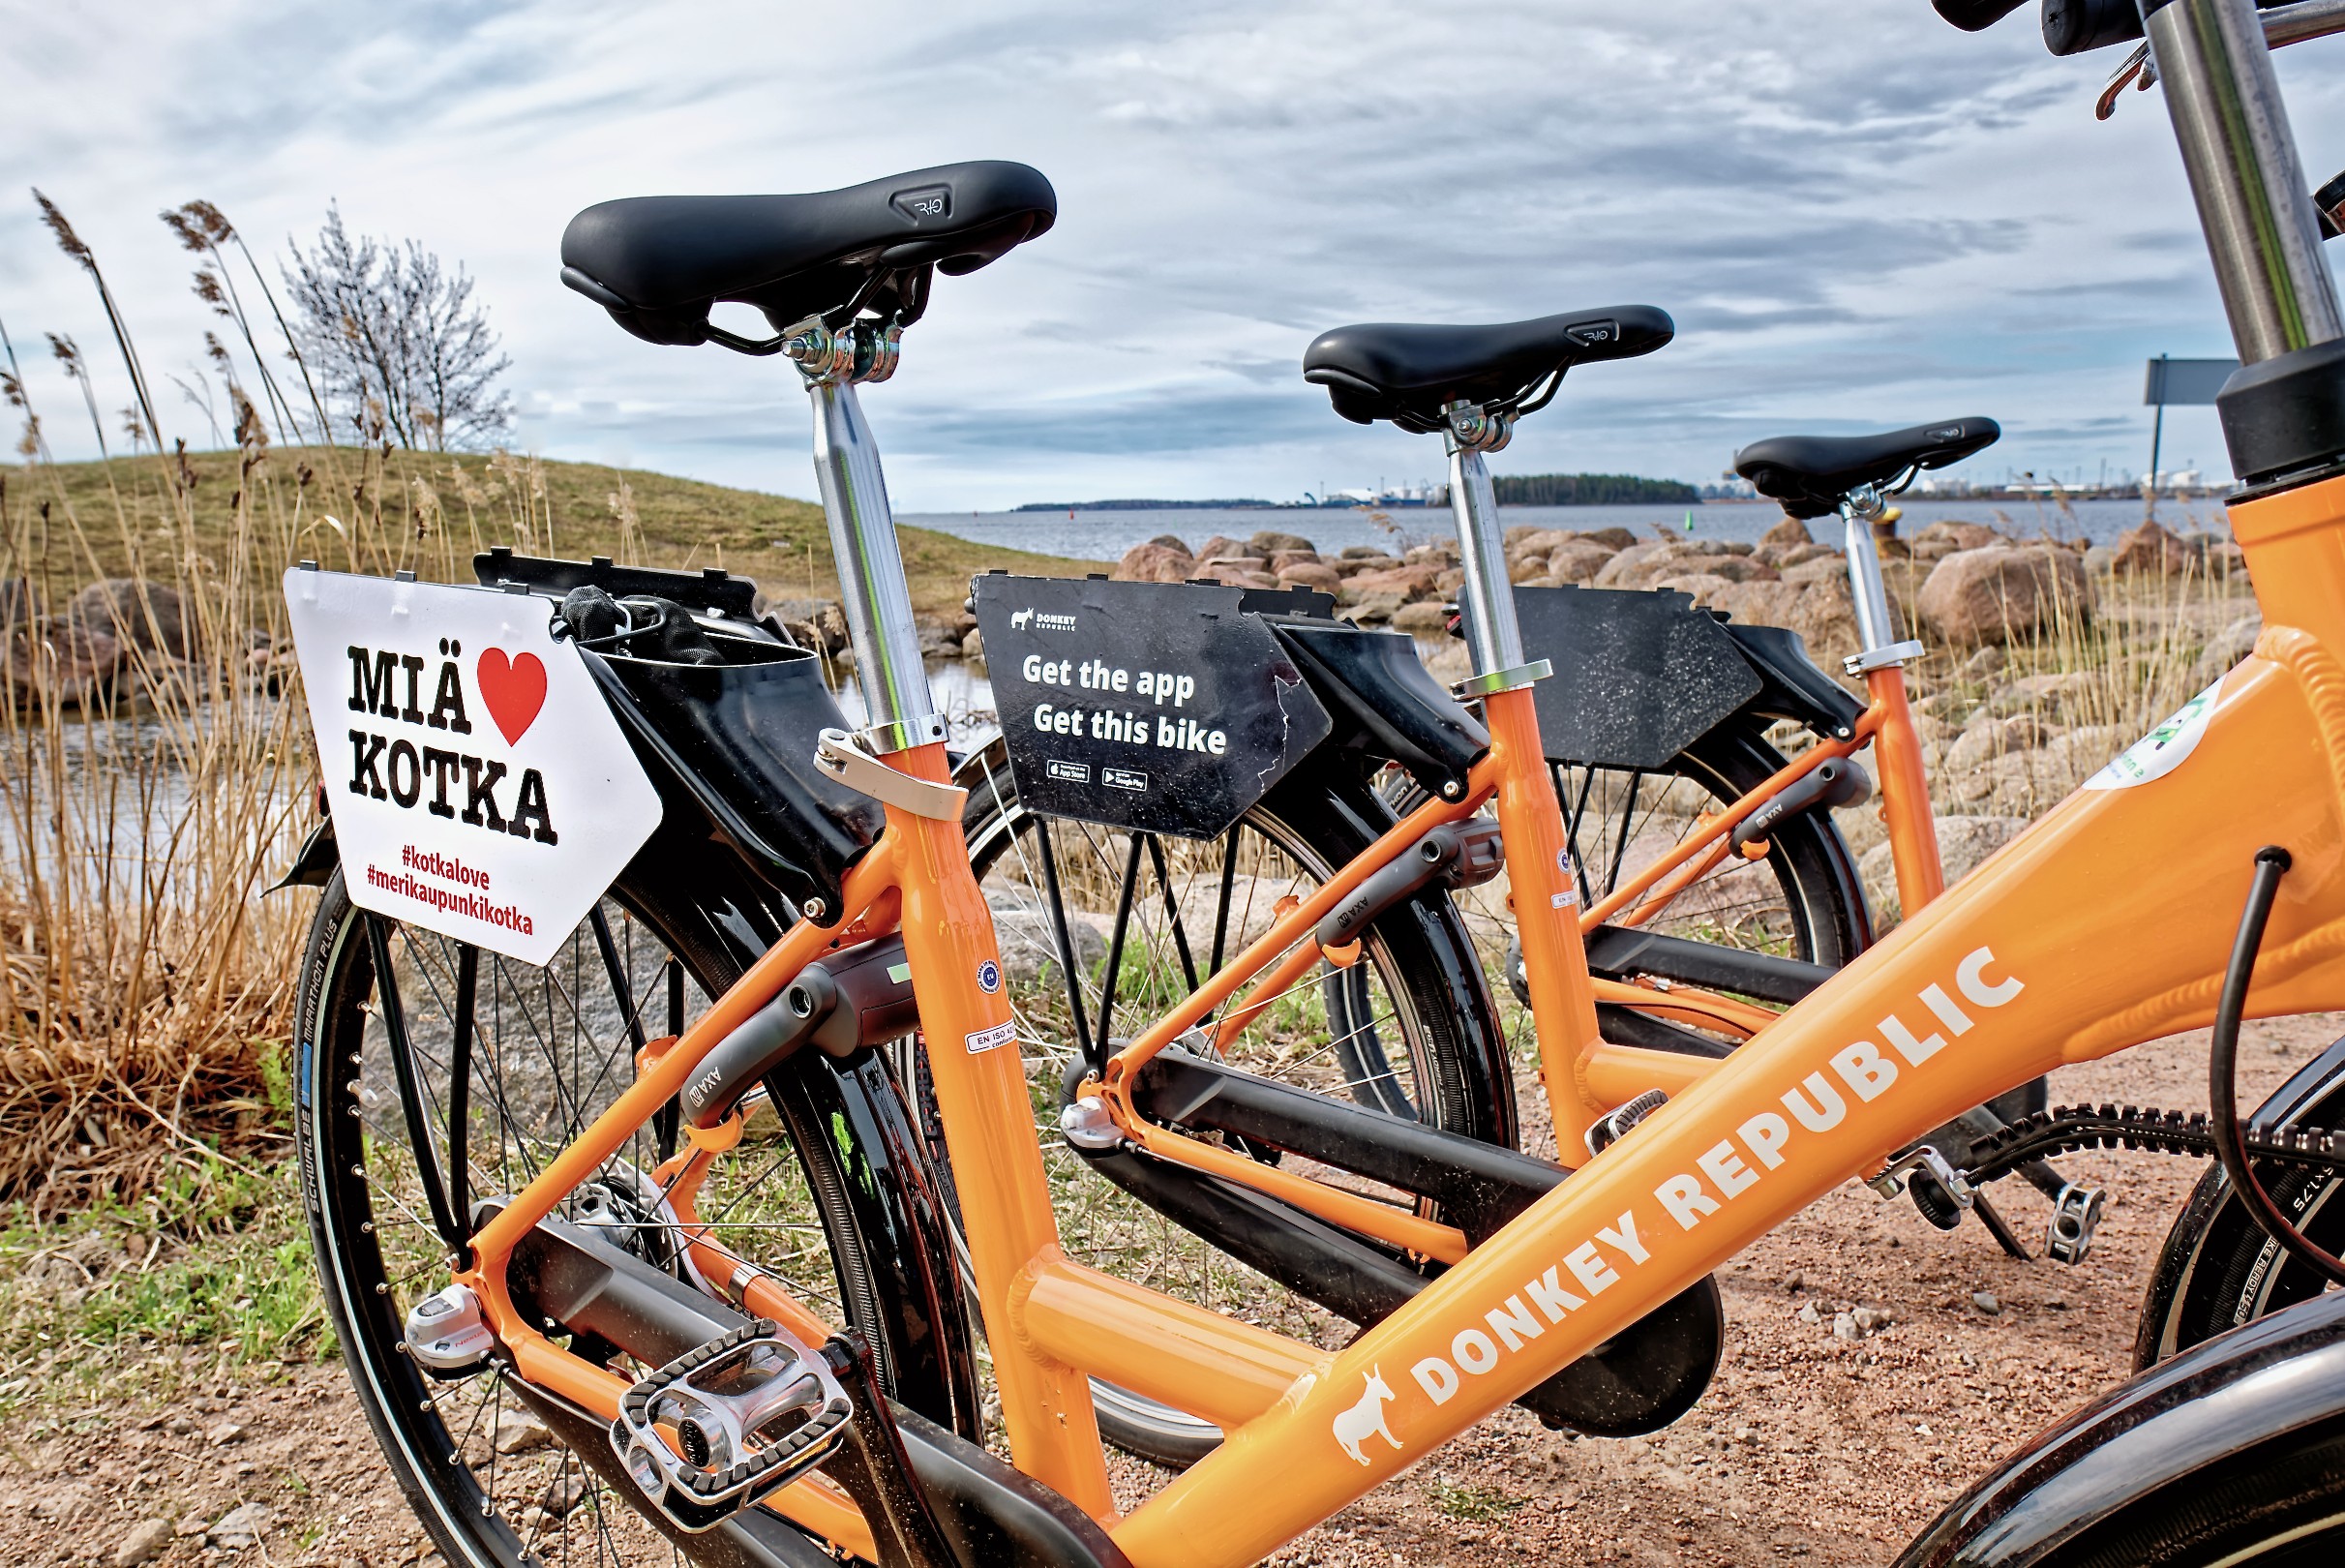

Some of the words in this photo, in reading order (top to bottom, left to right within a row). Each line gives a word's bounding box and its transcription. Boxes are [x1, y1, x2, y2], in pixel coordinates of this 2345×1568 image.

[1037, 614, 1076, 625] DONKEY
[346, 637, 472, 736] MIÄ
[1022, 654, 1071, 686] Get
[1078, 658, 1128, 692] the
[1135, 670, 1194, 708] app
[1034, 704, 1084, 737] Get
[1091, 708, 1149, 745] this
[1157, 716, 1227, 755] bike
[348, 728, 558, 846] KOTKA
[402, 845, 490, 890] #kotkalove
[367, 863, 533, 936] #merikaupunkikotka
[1347, 896, 1369, 917] AXA
[303, 959, 325, 1042] MARATHON
[319, 919, 338, 958] PLUS
[977, 1035, 990, 1045] EN
[992, 1030, 1006, 1040] ISO
[697, 1066, 722, 1094] AXA
[302, 1108, 319, 1214] SCHWALBE
[1409, 1208, 1651, 1406] DONKEY
[1653, 945, 2026, 1232] REPUBLIC
[455, 1331, 486, 1347] Nexus
